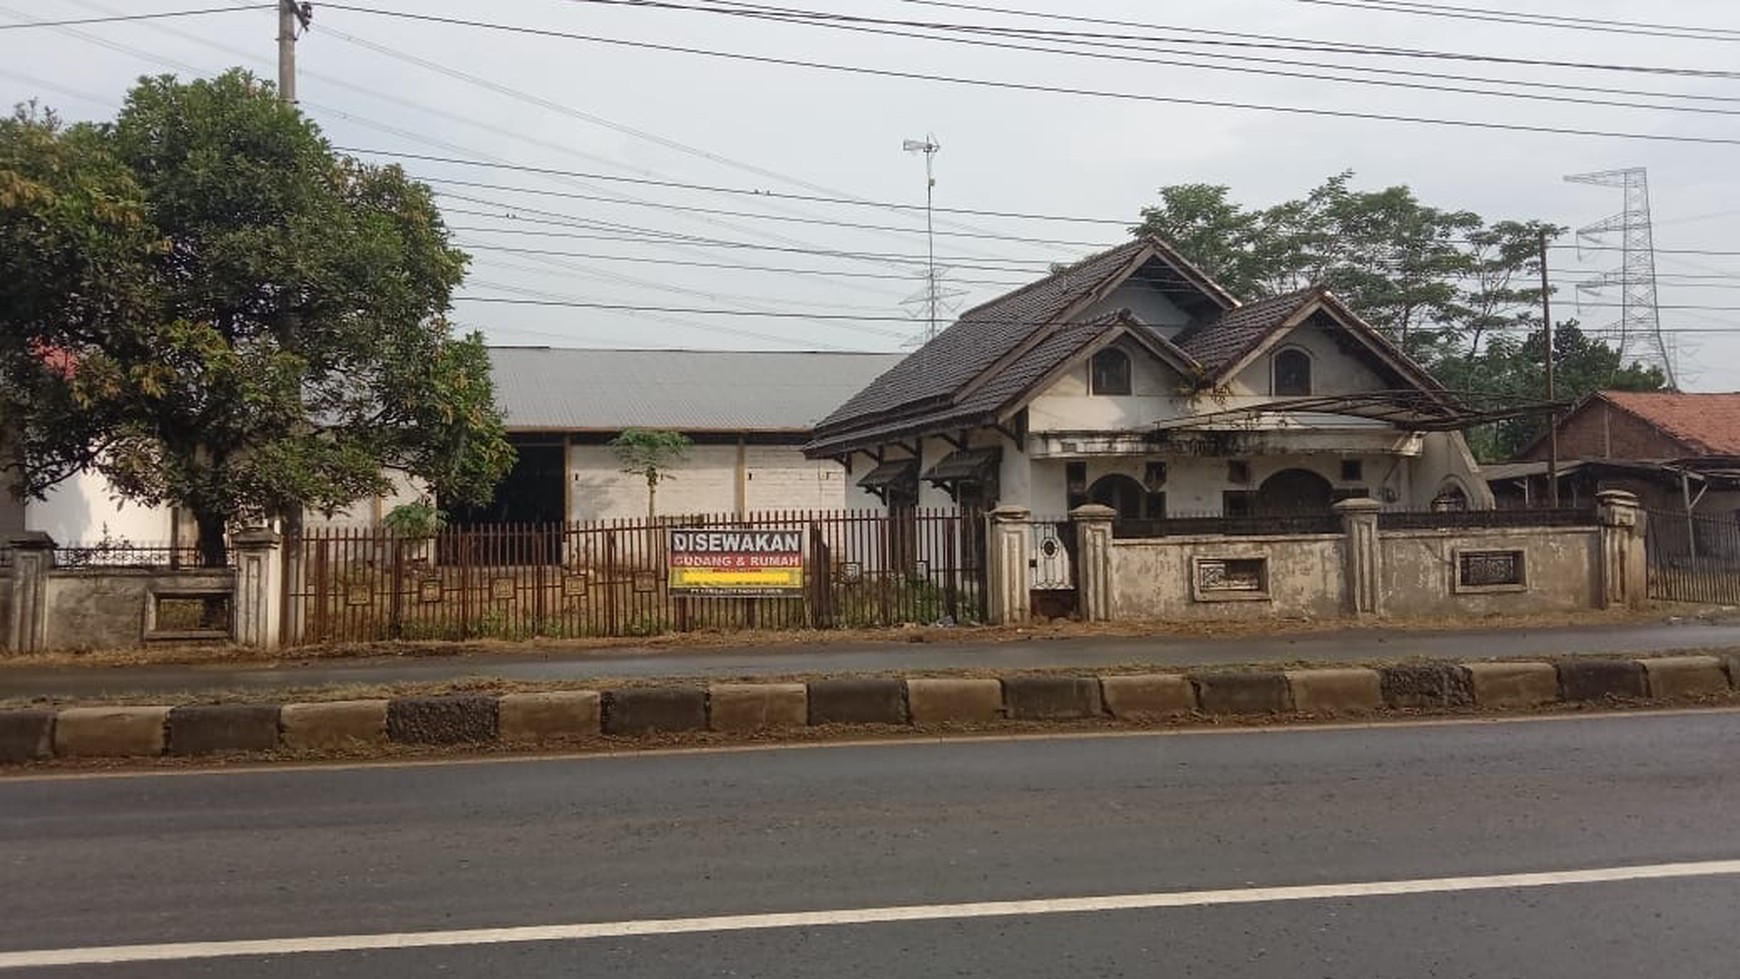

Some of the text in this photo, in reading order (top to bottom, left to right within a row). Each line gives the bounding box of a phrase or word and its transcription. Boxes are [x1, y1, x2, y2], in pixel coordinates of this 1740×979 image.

[673, 533, 799, 551] DISEWAKAN
[674, 556, 799, 566] GUDANG & RUMAH
